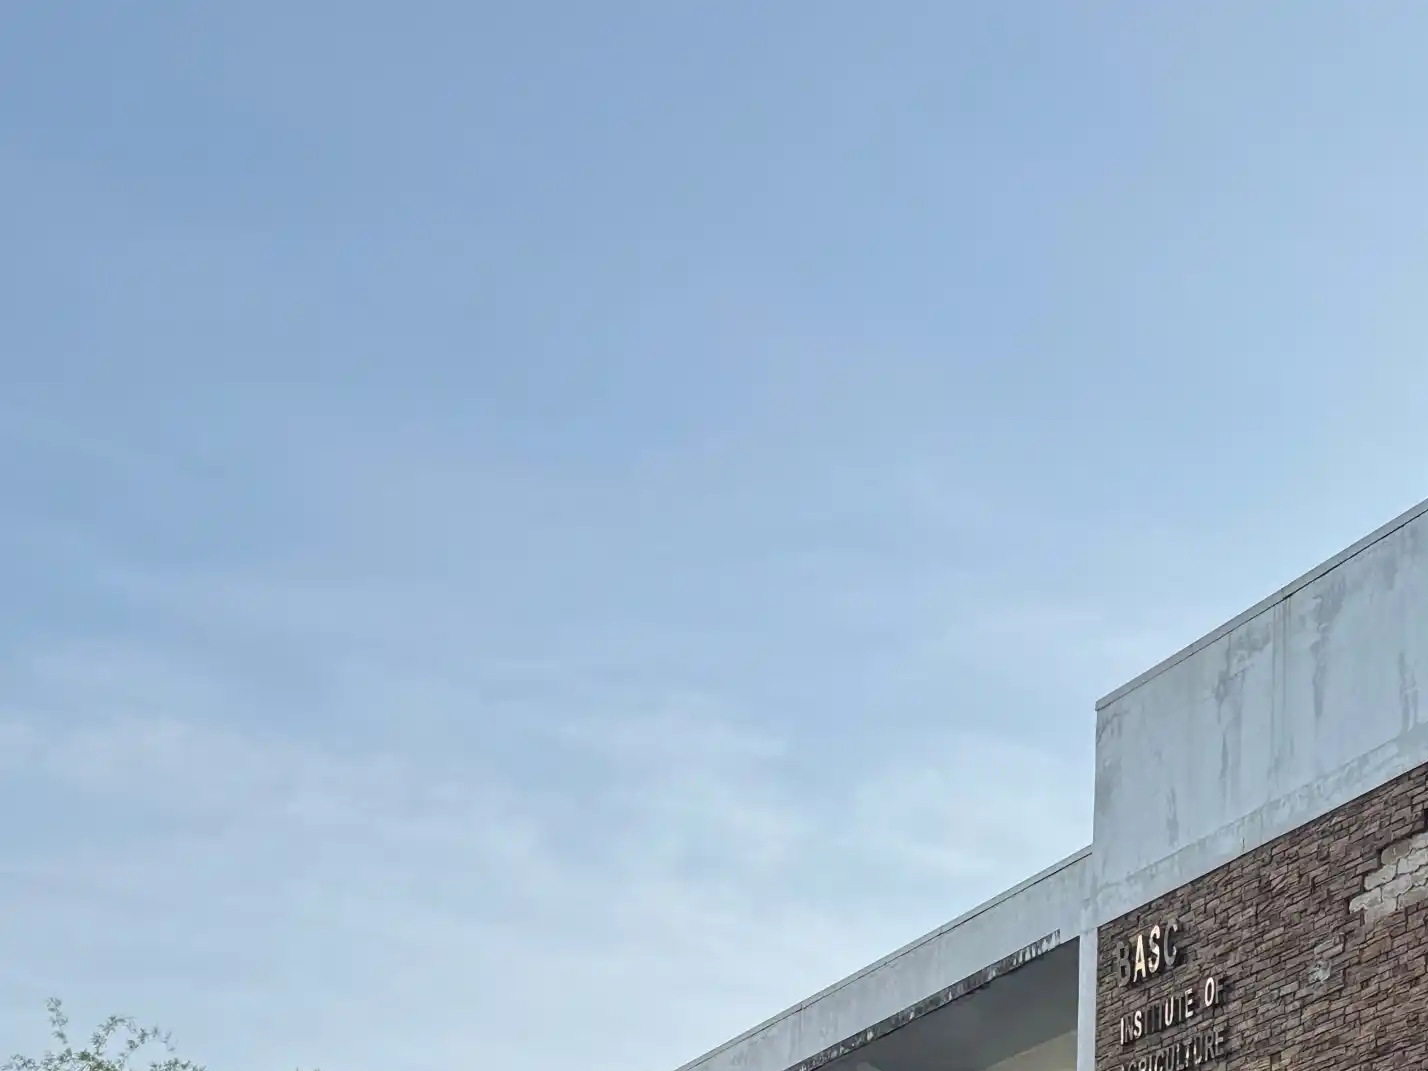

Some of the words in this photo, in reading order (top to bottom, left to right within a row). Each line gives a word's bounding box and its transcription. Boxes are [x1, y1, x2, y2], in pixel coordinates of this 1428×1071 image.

[1115, 919, 1179, 987] BASC
[1120, 988, 1194, 1046] INSTITUTE
[1204, 977, 1227, 1008] OF
